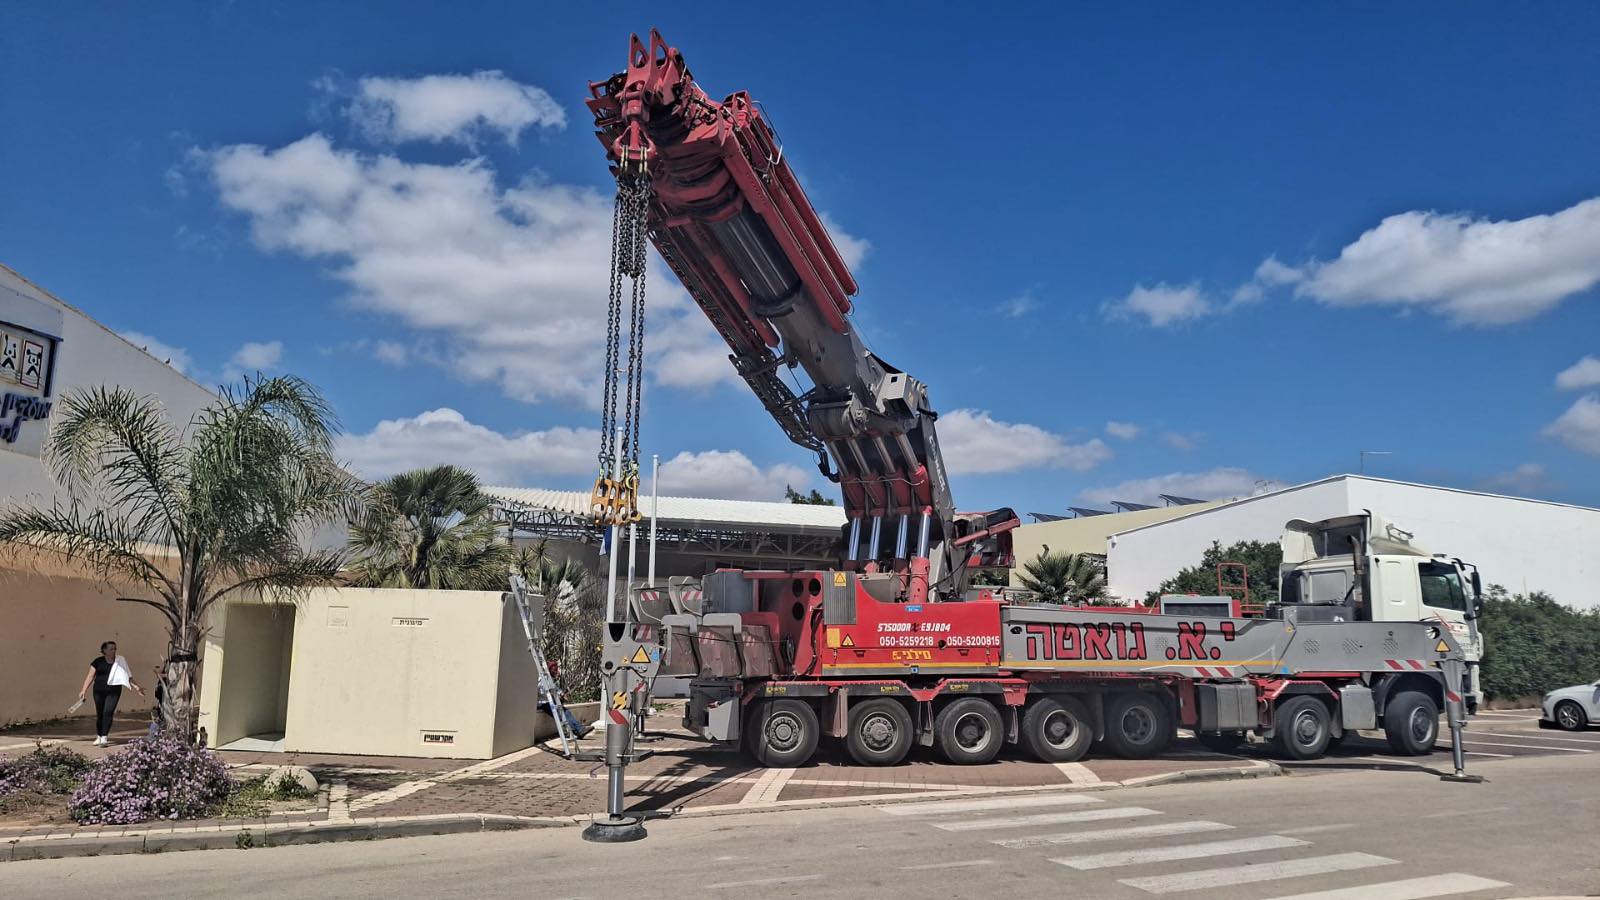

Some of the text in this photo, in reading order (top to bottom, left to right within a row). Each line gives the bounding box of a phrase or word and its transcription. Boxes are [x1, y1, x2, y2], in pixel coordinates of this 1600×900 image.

[879, 635, 1000, 647] 050-5259218 050-5200815
[1026, 621, 1236, 661] י.א. גואטה
